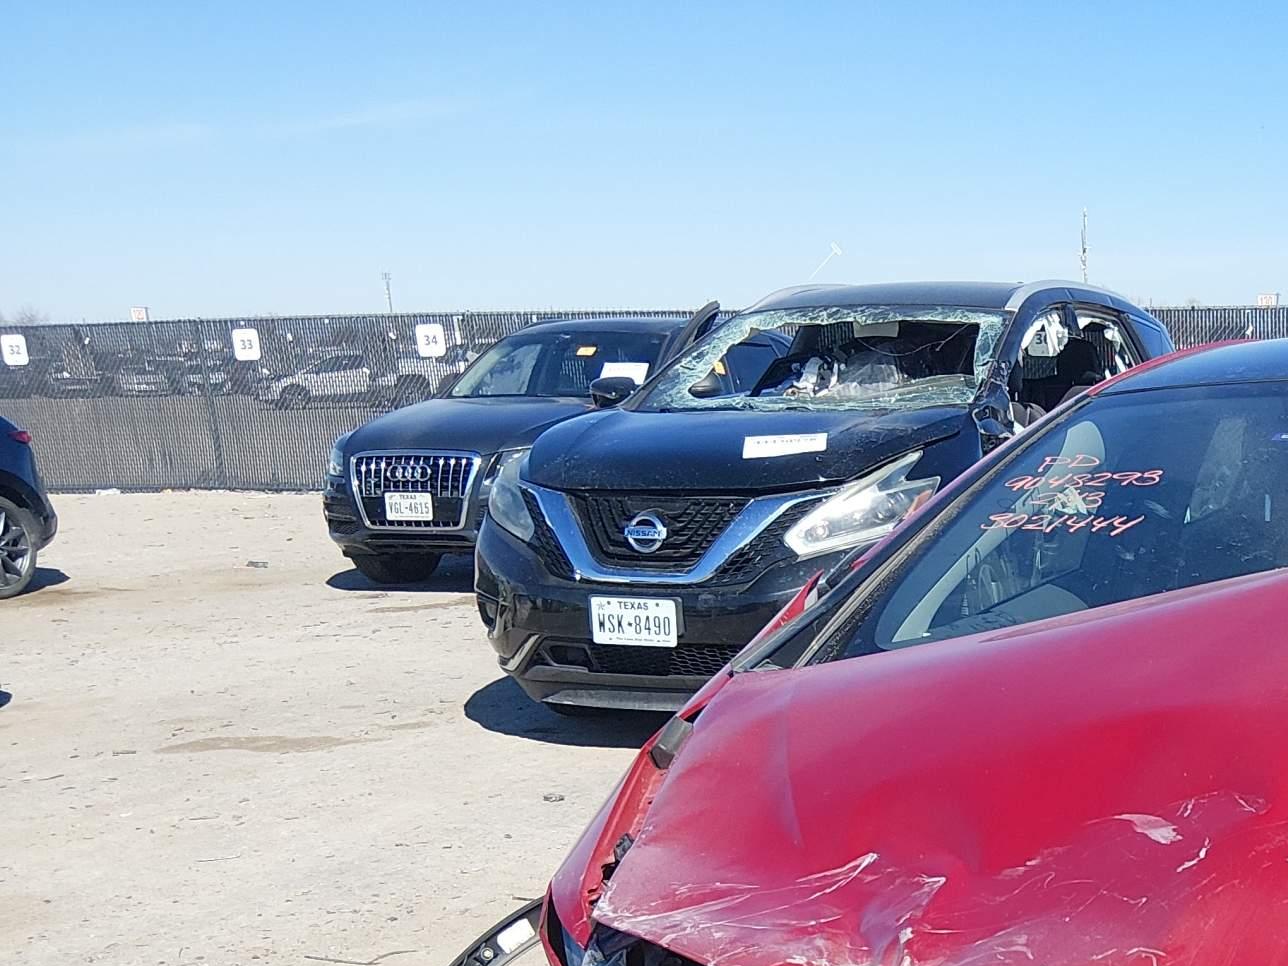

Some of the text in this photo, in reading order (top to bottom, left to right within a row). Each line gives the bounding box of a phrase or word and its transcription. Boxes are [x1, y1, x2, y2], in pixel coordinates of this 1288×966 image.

[424, 335, 438, 346] 34
[1035, 331, 1048, 345] 3
[8, 344, 21, 355] 32
[240, 339, 253, 350] 33
[388, 502, 430, 514] VGL-4615
[627, 529, 662, 538] NISSAN
[617, 600, 649, 611] TEXAS
